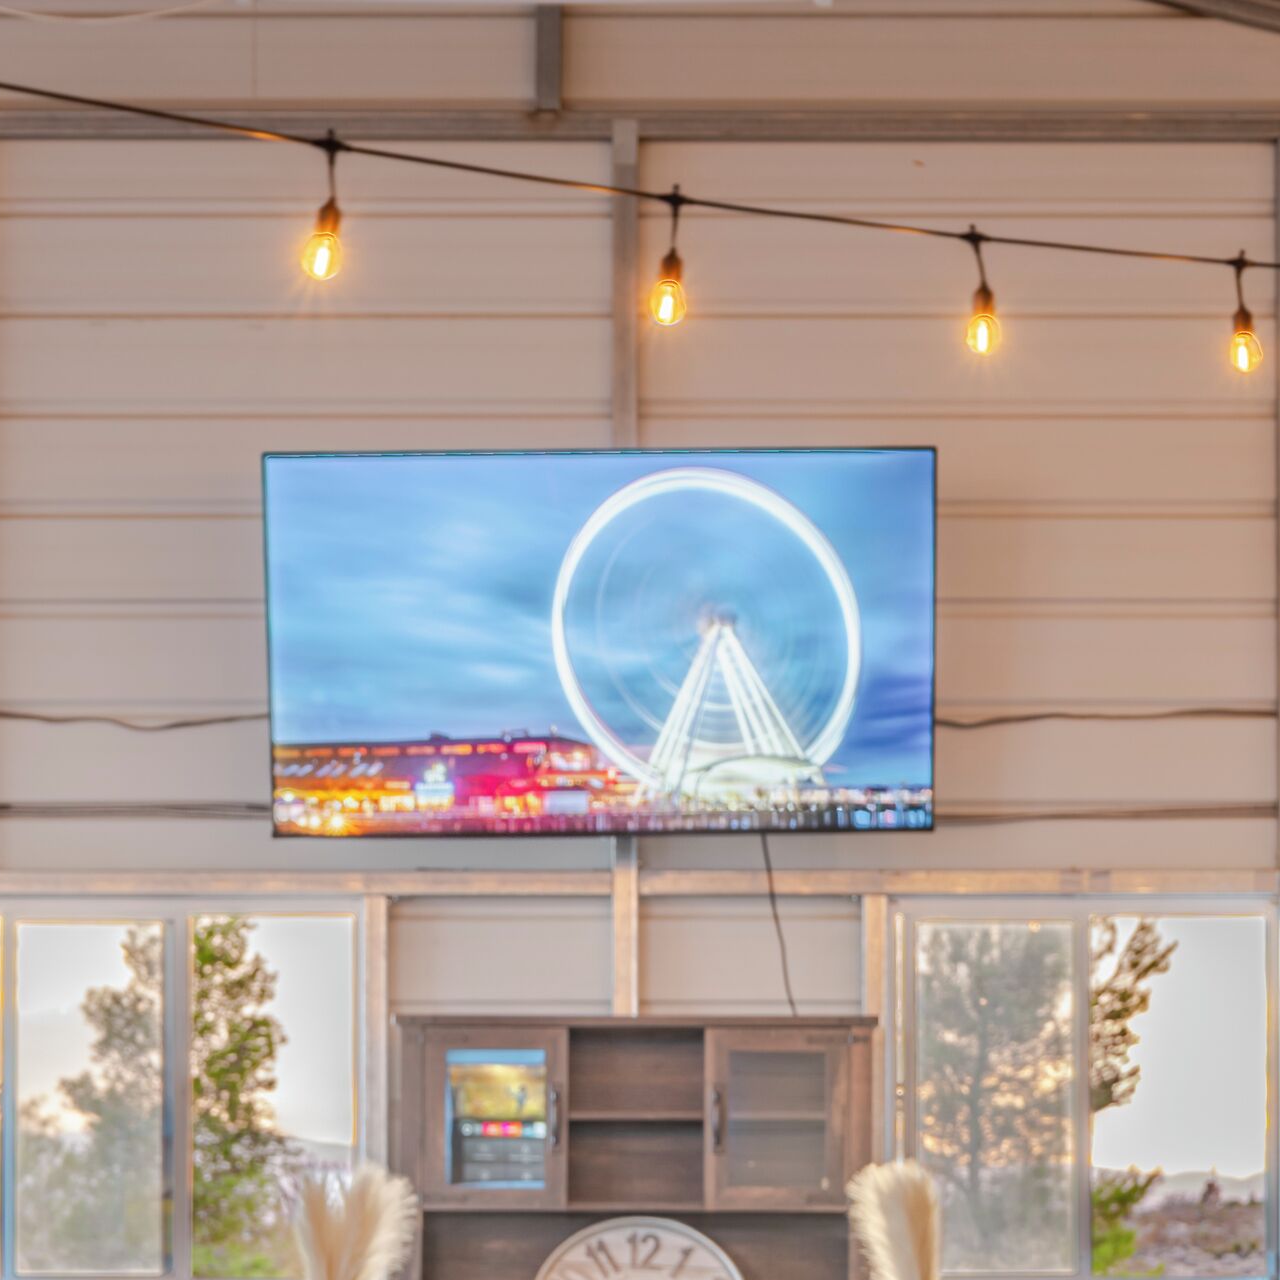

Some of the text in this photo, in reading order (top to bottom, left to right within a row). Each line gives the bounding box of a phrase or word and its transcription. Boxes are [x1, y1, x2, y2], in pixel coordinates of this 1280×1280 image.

[585, 1238, 621, 1279] 11
[626, 1232, 663, 1271] 12
[670, 1245, 696, 1278] 1
